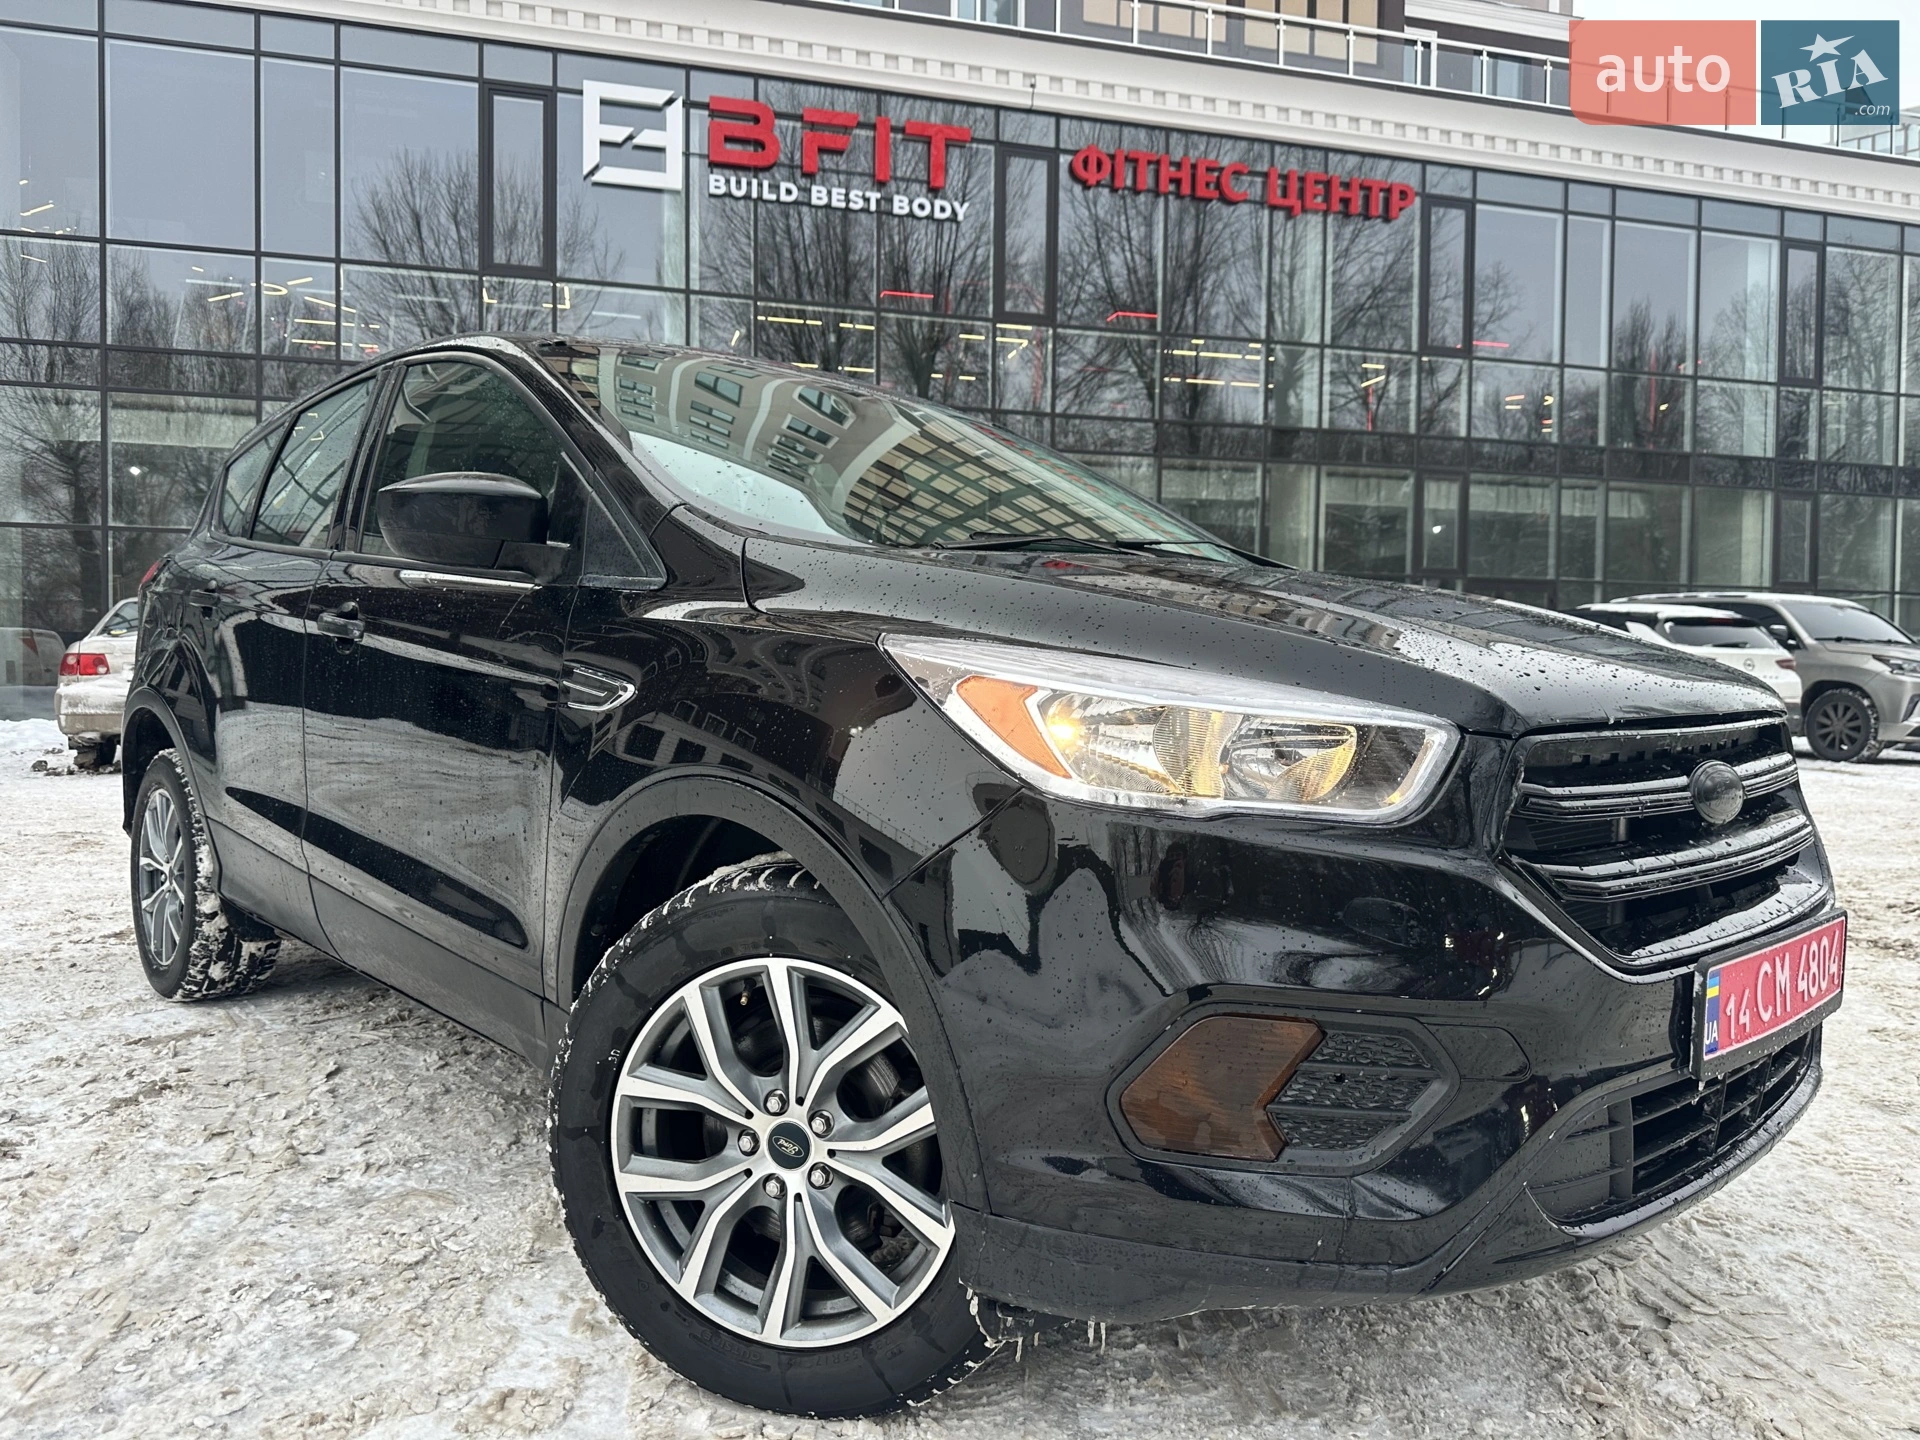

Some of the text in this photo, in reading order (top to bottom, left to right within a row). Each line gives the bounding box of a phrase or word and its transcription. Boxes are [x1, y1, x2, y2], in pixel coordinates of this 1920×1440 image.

[709, 95, 972, 190] BFIT
[708, 174, 971, 222] BUILD BEST BODY
[1071, 144, 1416, 220] ФІТНЕС ЦЕНТР
[1725, 929, 1840, 1040] 14 CM 4804
[1705, 1020, 1719, 1045] UA
